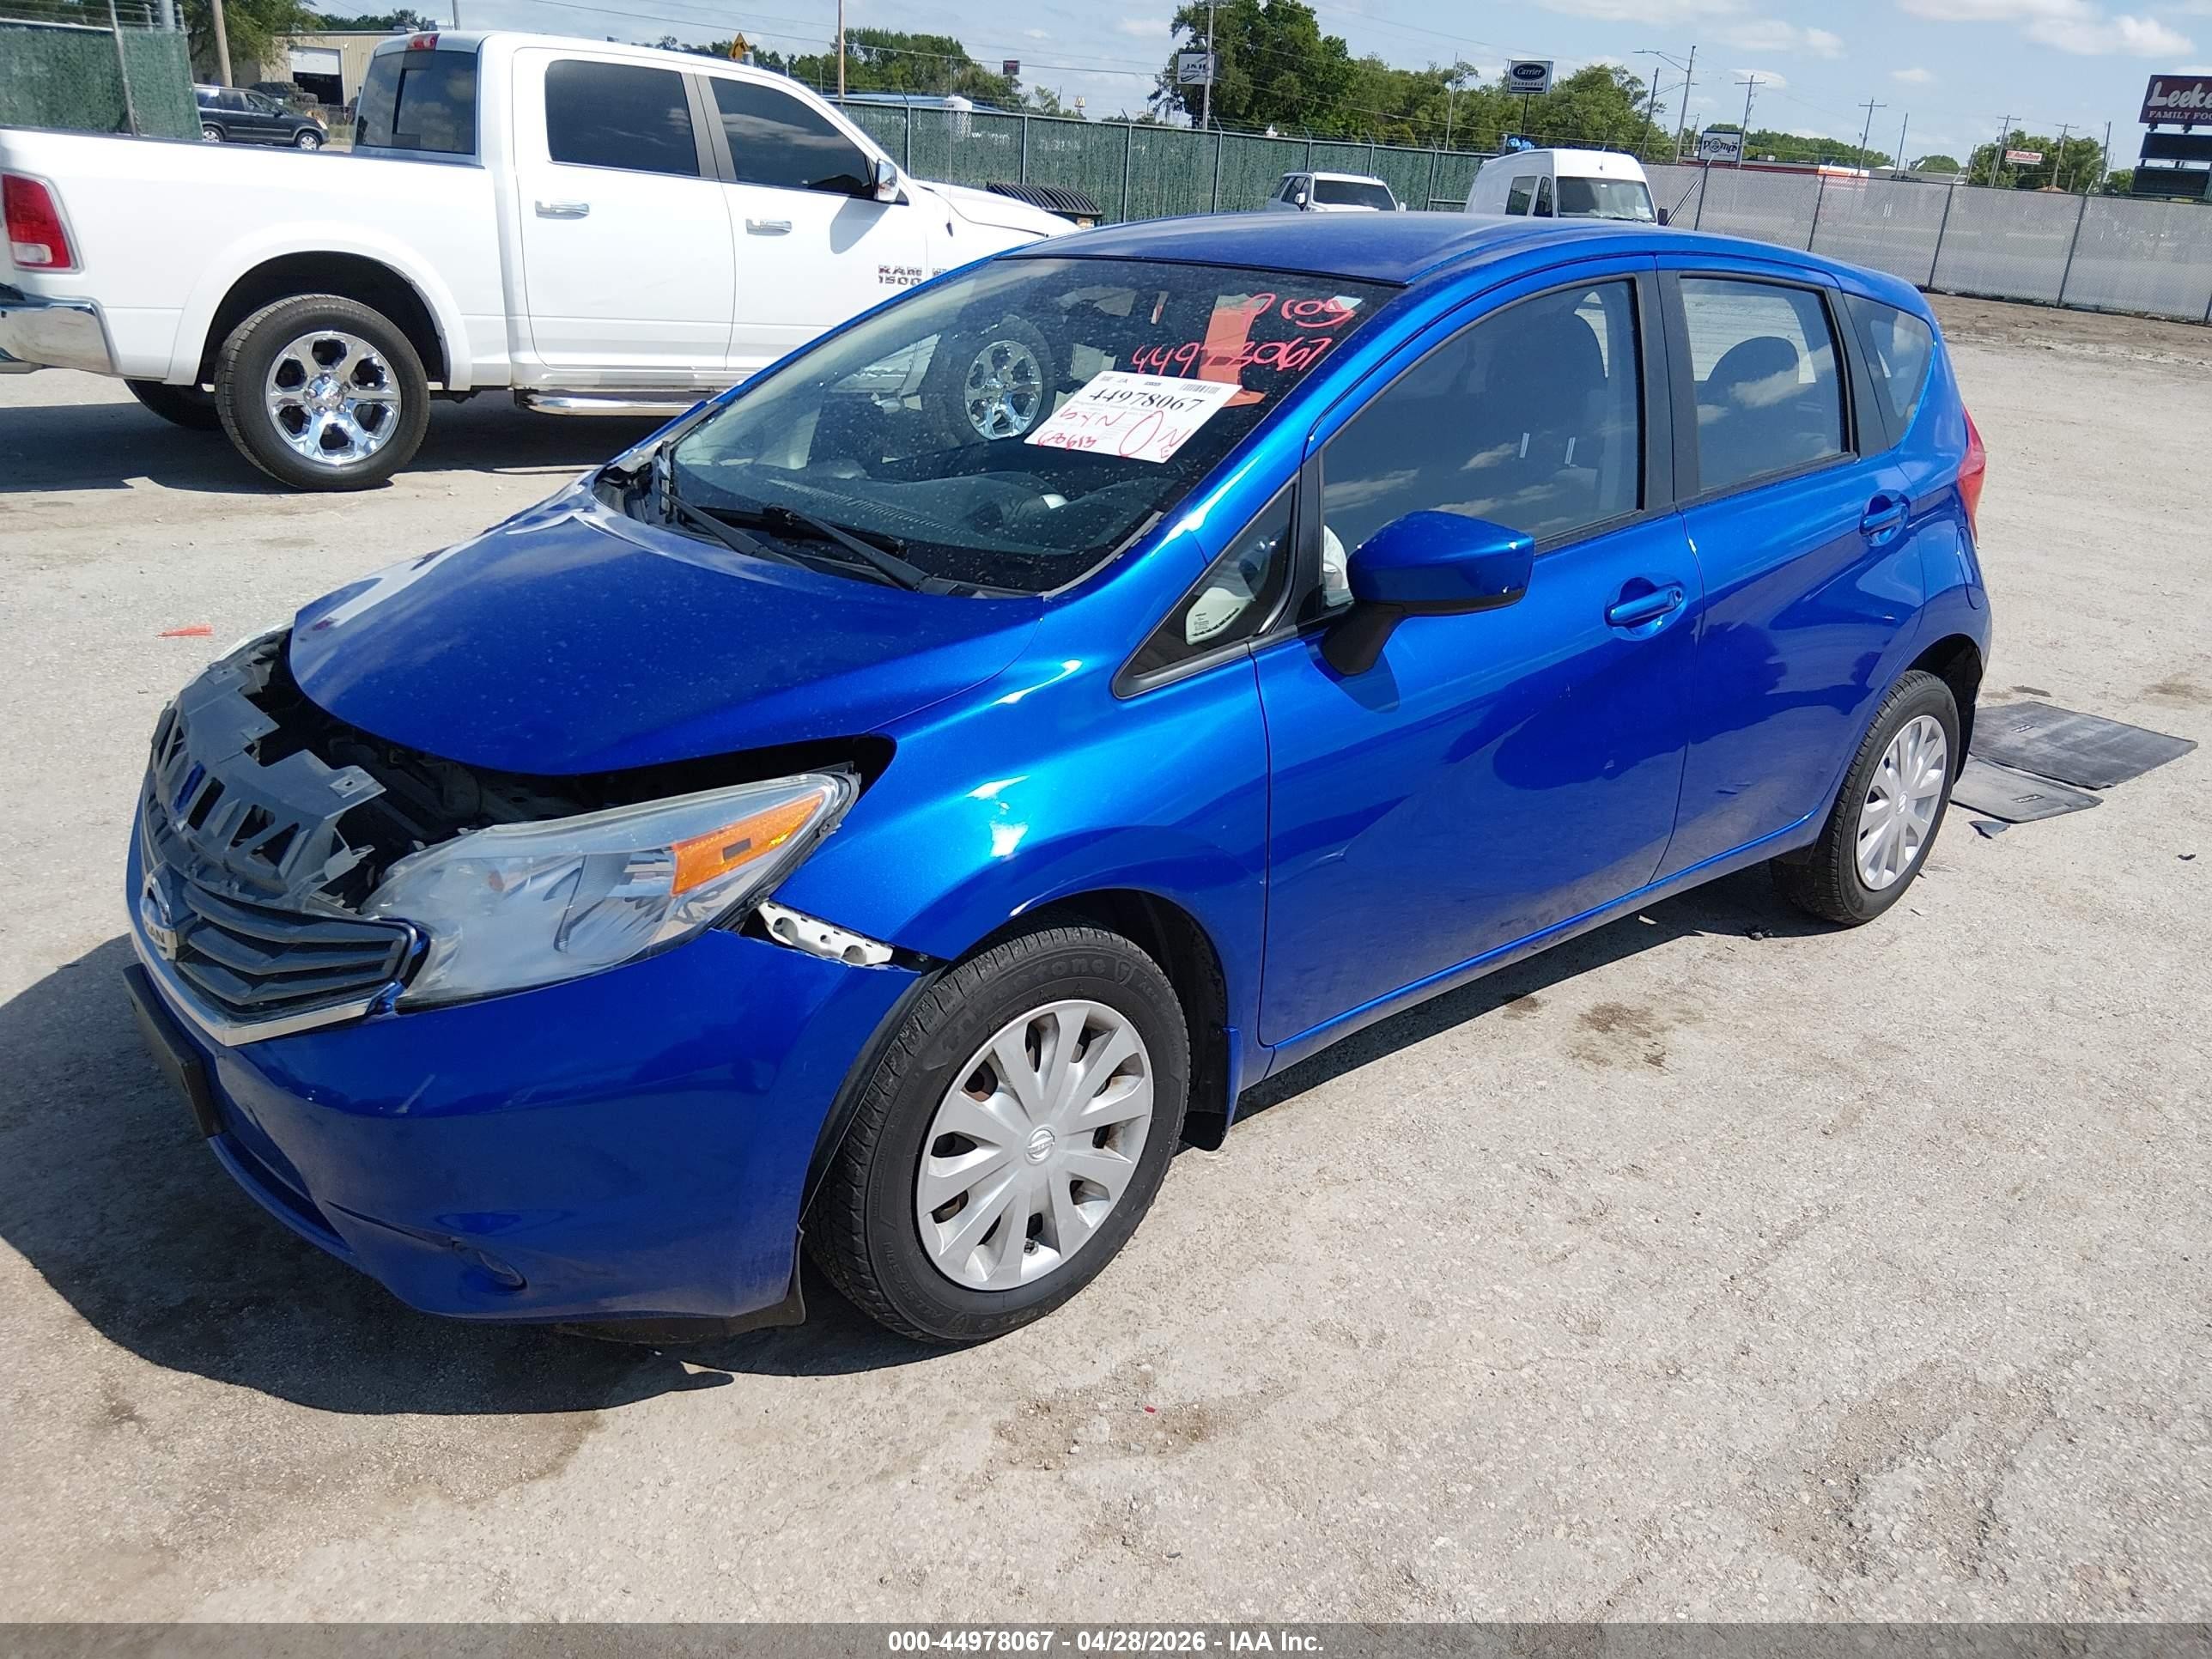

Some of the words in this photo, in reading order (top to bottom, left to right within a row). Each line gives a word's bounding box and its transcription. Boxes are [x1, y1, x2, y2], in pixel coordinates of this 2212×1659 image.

[1517, 67, 1542, 76] Carrier
[2148, 111, 2191, 119] FAMILY
[878, 265, 922, 276] RAM
[1090, 388, 1205, 412] 44978067
